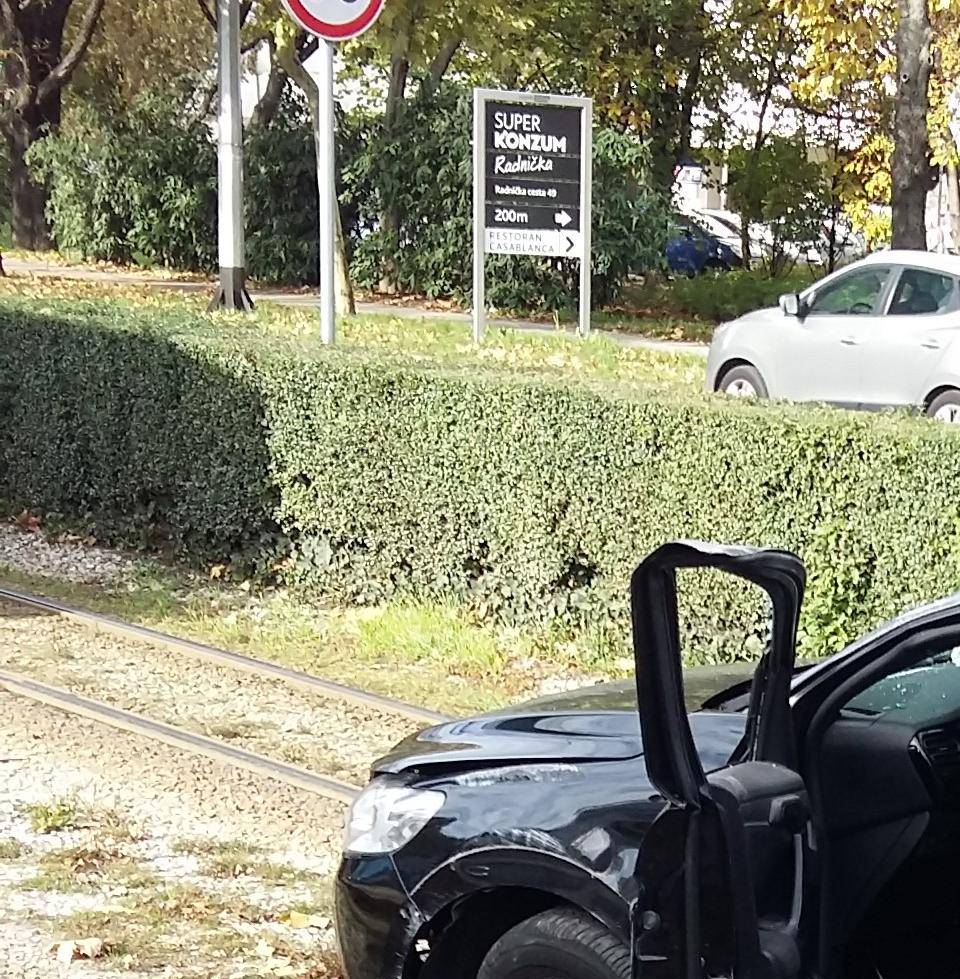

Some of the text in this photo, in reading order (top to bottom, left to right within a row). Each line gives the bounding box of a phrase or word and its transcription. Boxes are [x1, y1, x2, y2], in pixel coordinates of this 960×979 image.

[494, 112, 541, 132] SUPER
[494, 131, 566, 153] KONZUM
[494, 155, 553, 174] Radnička
[494, 209, 529, 223] 200m
[489, 231, 542, 242] RESTORAN
[489, 242, 554, 253] CASABLANCA
